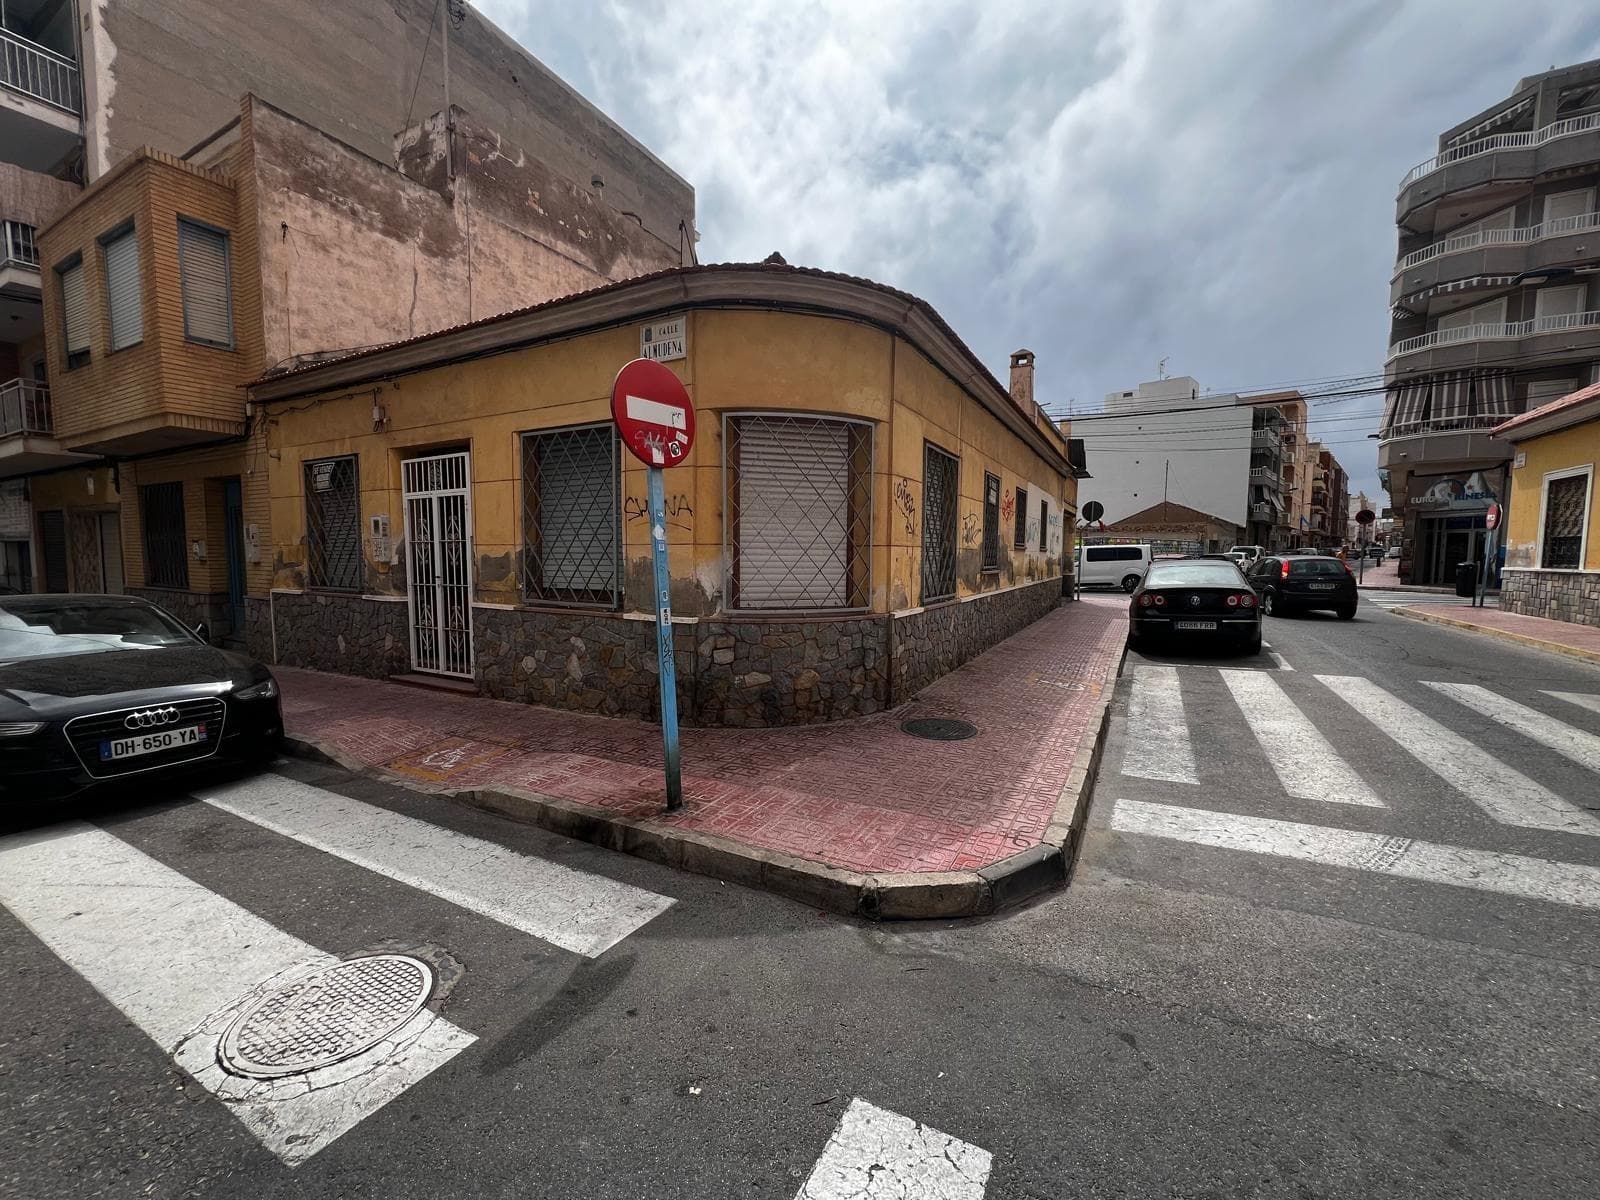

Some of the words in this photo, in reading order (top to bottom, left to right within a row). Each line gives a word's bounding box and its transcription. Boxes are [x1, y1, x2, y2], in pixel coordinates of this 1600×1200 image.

[658, 324, 679, 336] CALLE
[643, 340, 683, 359] ALMUDENA
[113, 729, 197, 756] DH-650-YA
